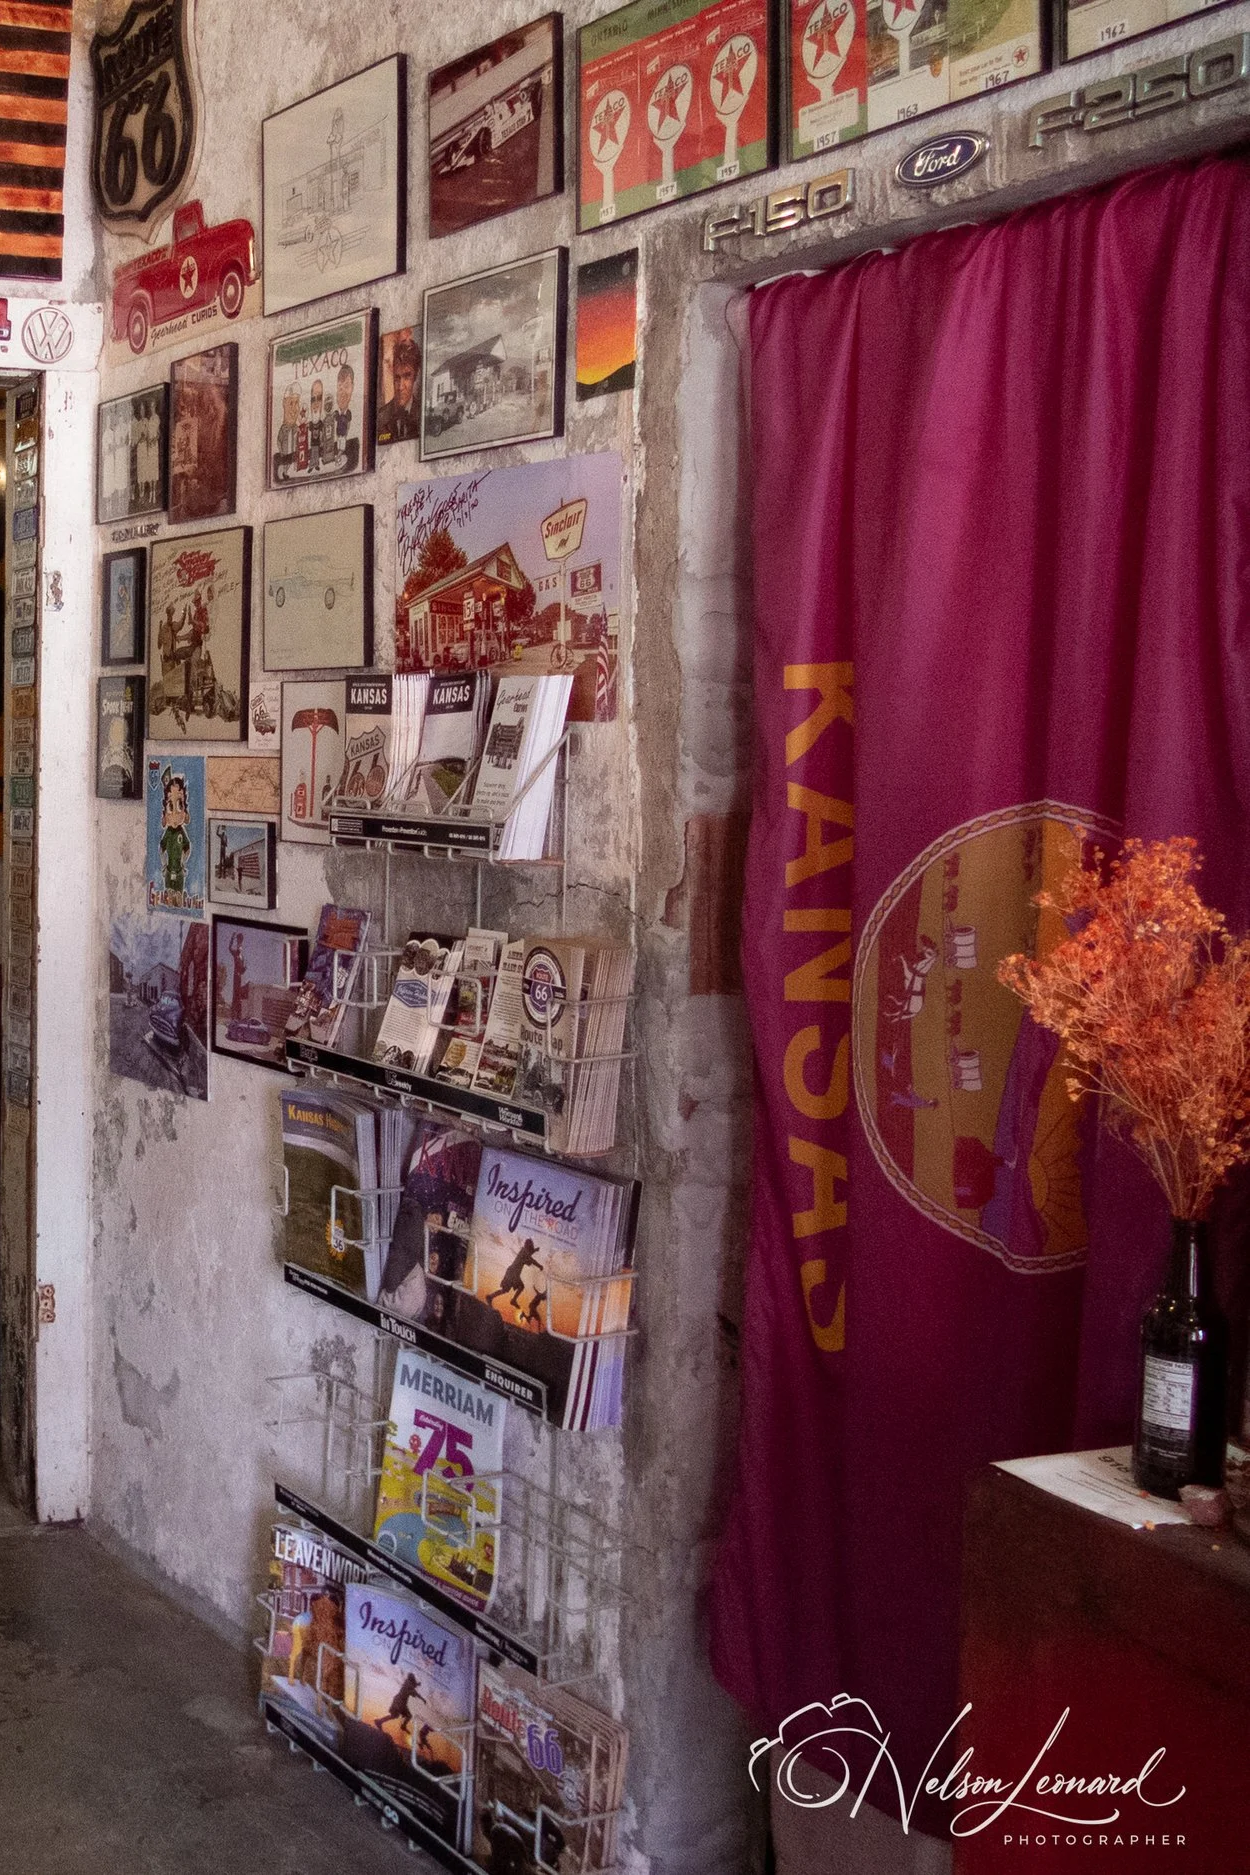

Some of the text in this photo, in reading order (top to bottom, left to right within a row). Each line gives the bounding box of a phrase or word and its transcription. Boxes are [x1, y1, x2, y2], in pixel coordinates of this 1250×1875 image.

[807, 2, 849, 35] TEXACO
[1100, 22, 1127, 42] 1962
[714, 42, 752, 73] TEXACO
[985, 70, 1010, 89] 1967
[896, 103, 919, 121] 1963
[104, 70, 177, 206] 66
[816, 131, 838, 149] 1957
[720, 164, 739, 178] 1957
[913, 144, 962, 178] Ford
[291, 347, 350, 381] TEXACO
[544, 509, 583, 539] Sinclair
[350, 688, 388, 706] KANSAS
[432, 685, 471, 706] KANSAS
[350, 734, 382, 756] KANSAS
[534, 984, 548, 1001] 66
[783, 660, 855, 1353] KANSAS
[287, 1104, 325, 1127] KANSAS
[486, 1162, 583, 1234] Inspired
[399, 1363, 495, 1427] MERRIAM
[484, 1368, 534, 1402] ENQUIRER
[413, 1408, 475, 1493] 75
[274, 1530, 371, 1585] LEAVENWORT
[359, 1601, 448, 1668] Inspired
[526, 1722, 564, 1777] 66
